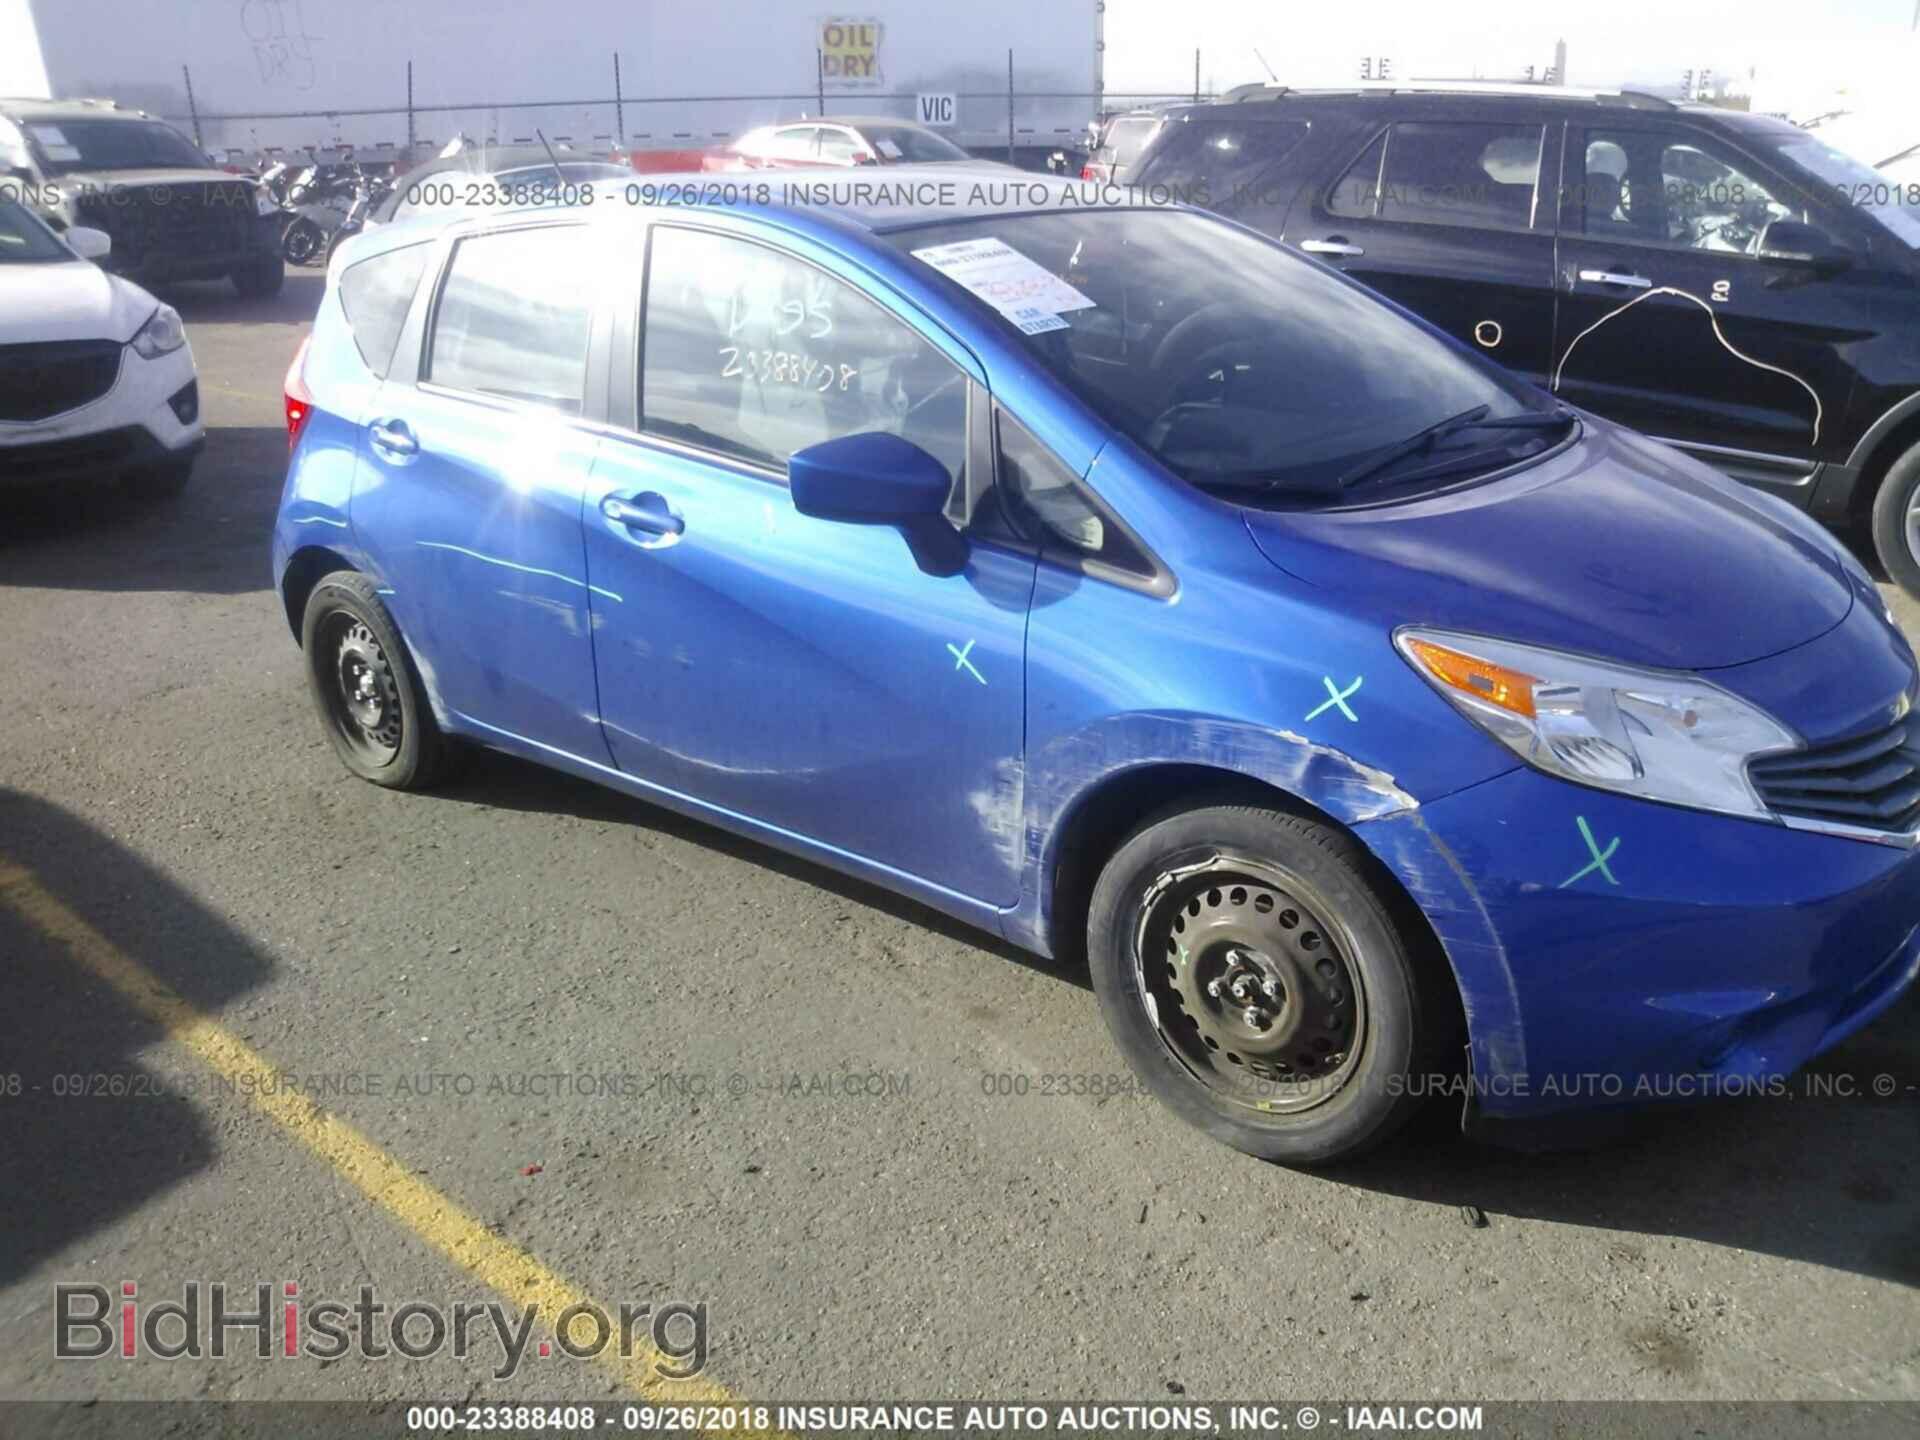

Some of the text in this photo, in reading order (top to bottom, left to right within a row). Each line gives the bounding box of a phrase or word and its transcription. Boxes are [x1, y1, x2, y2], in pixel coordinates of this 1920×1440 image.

[823, 24, 874, 48] OIL
[823, 53, 875, 77] DRY
[921, 96, 953, 122] VIC
